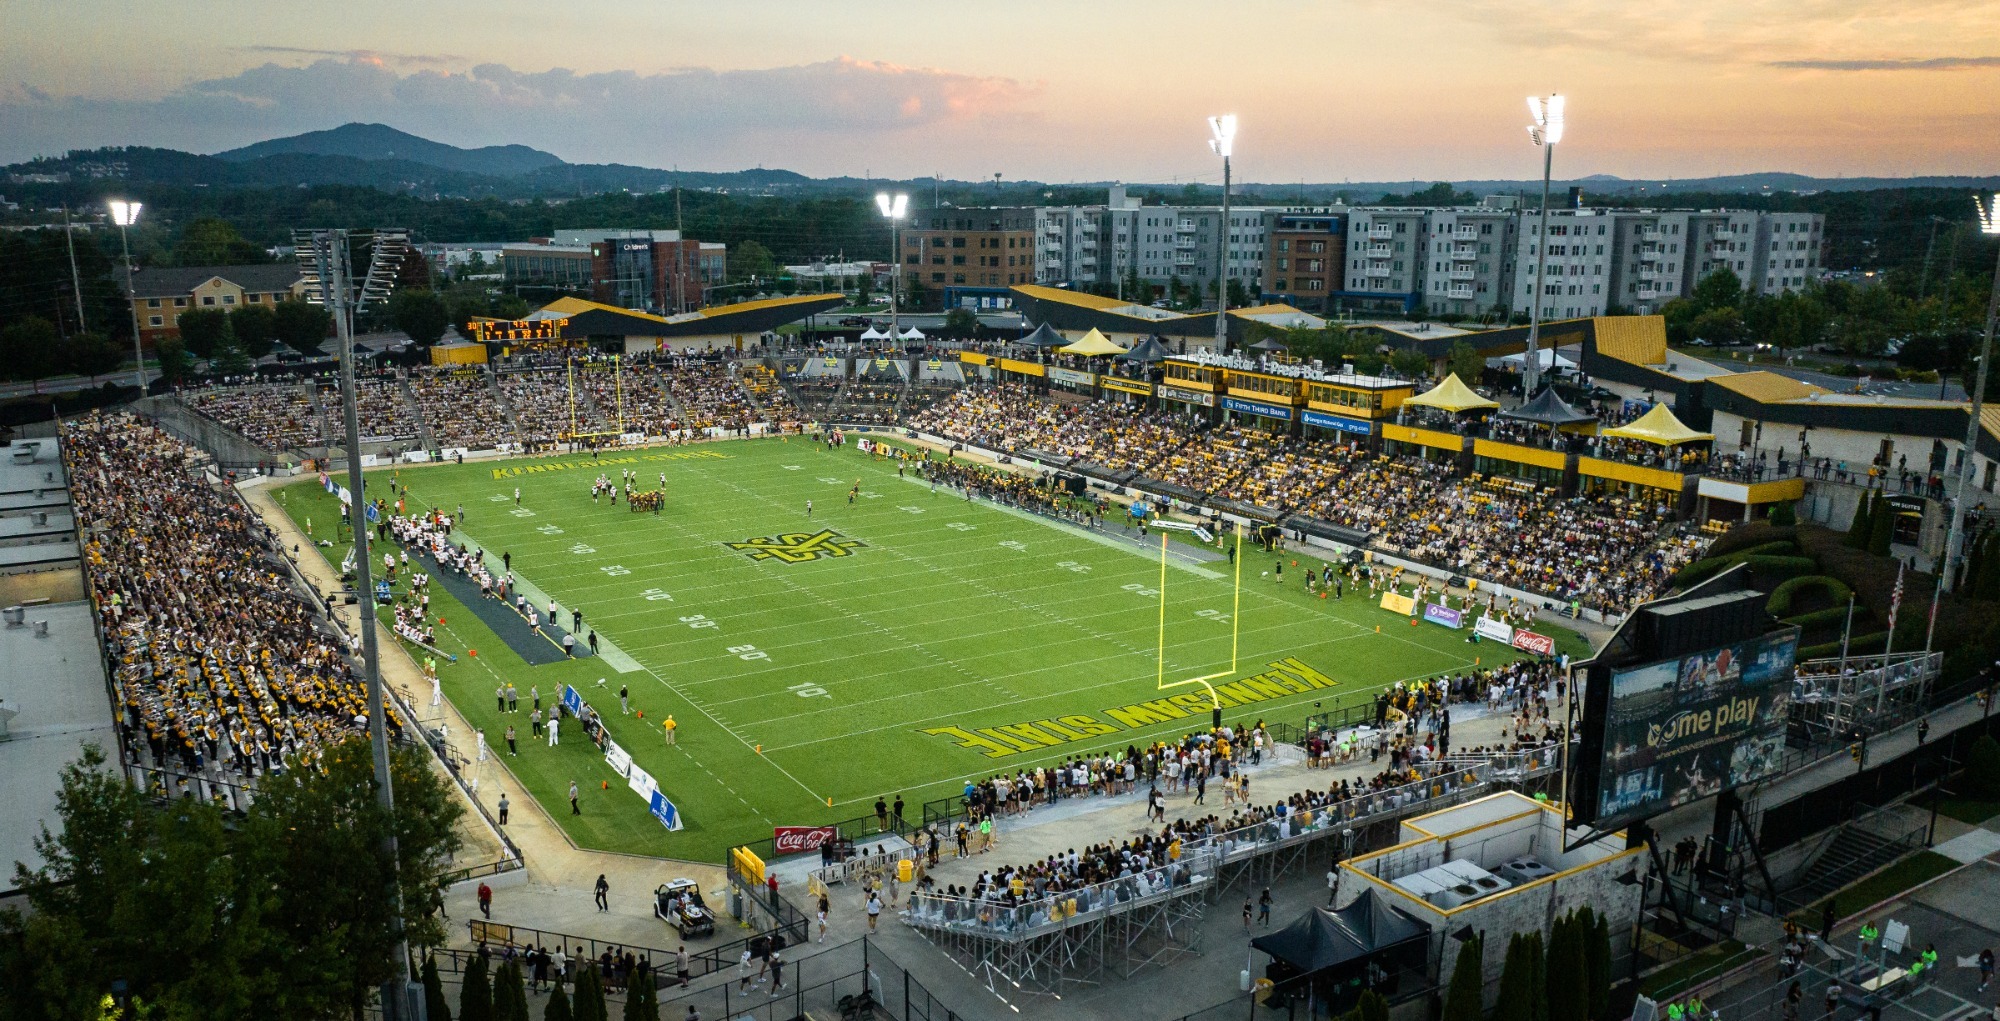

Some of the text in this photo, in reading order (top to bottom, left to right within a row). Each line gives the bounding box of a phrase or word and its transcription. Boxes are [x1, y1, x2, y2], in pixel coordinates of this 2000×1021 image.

[1235, 401, 1286, 418] FIFTH THIRD BANK
[1626, 453, 1638, 461] 102
[679, 614, 716, 629] 30
[726, 644, 768, 661] 20
[787, 682, 828, 698] 10
[916, 655, 1342, 759] KENNESAW STATE
[1714, 695, 1760, 735] play
